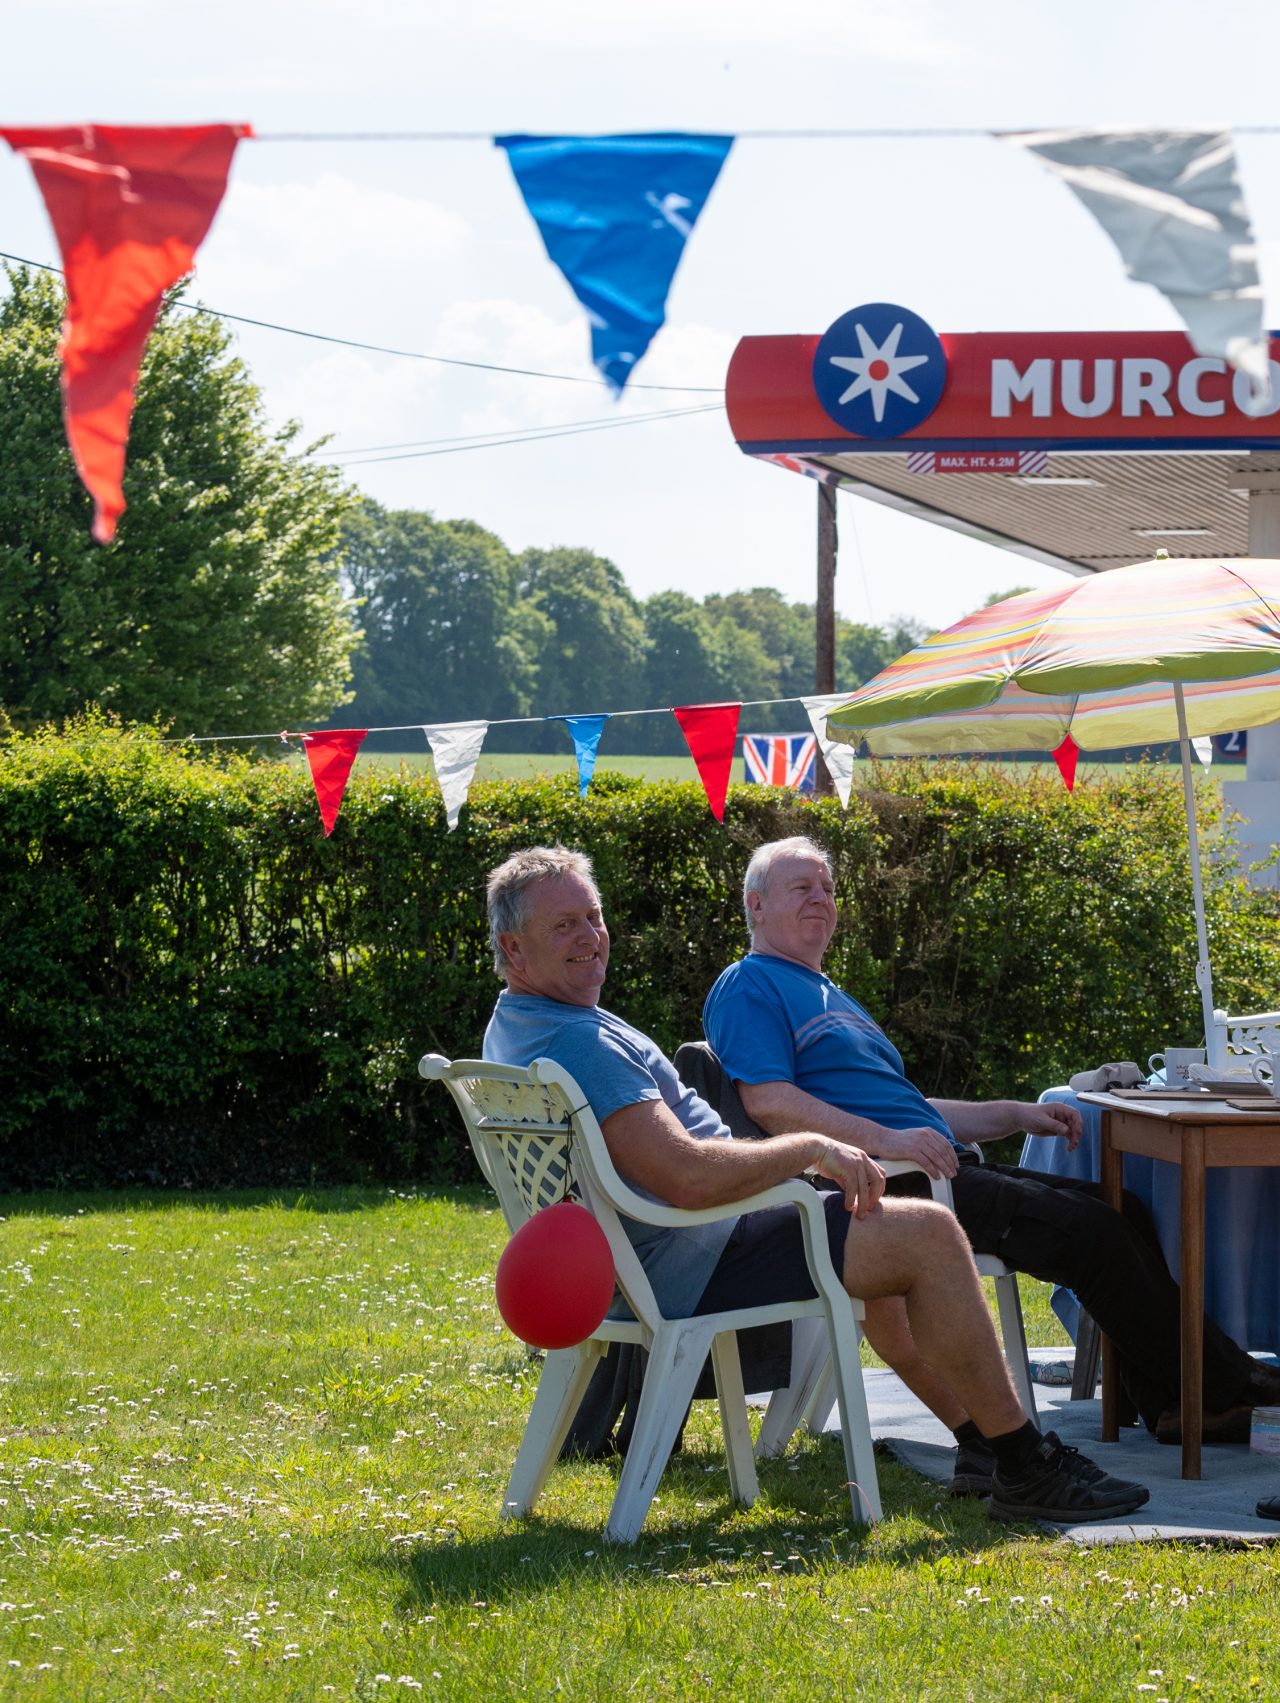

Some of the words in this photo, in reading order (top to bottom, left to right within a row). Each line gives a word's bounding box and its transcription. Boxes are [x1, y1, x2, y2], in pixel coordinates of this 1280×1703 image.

[940, 457, 968, 467] MAX.
[970, 457, 987, 467] HT.
[989, 457, 1015, 467] 4.2M
